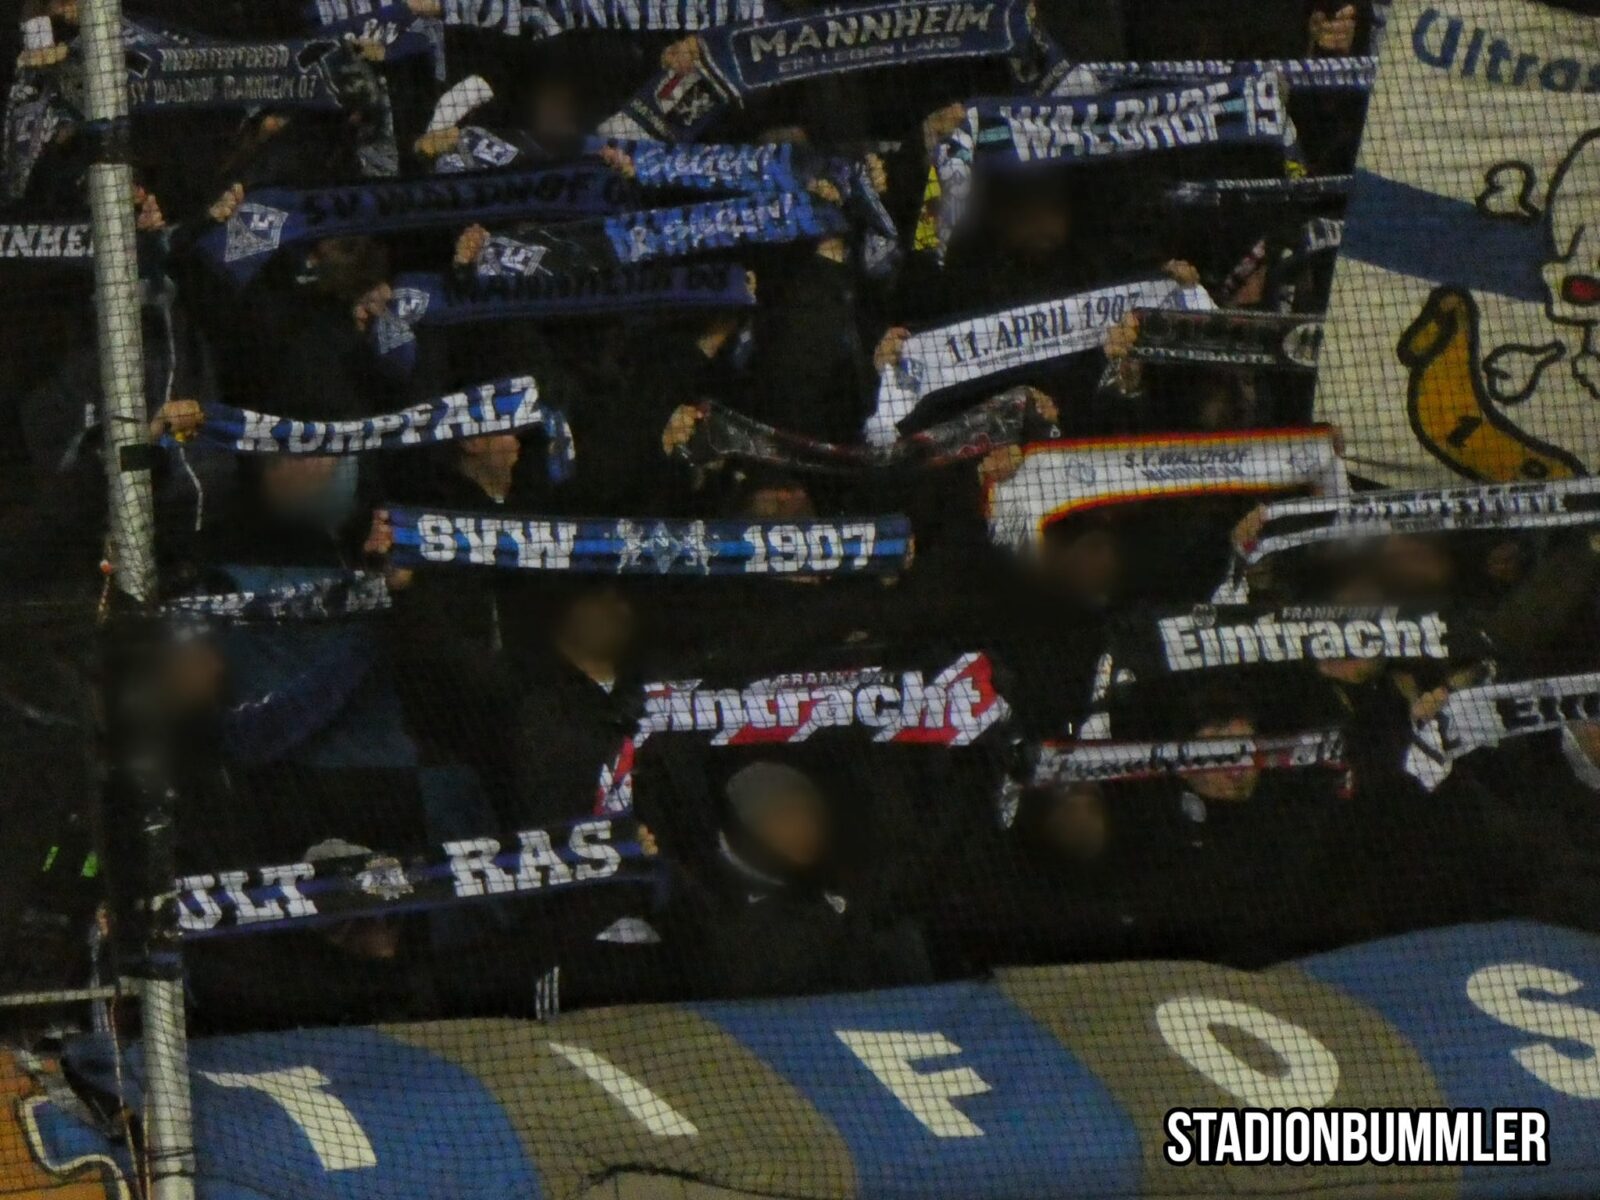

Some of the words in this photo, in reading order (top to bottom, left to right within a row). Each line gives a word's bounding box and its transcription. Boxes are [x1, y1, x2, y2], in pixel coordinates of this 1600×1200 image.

[749, 3, 995, 63] MANNHEIM
[1004, 81, 1230, 163] WALDHOF
[0, 224, 94, 258] NHE
[995, 309, 1074, 351] APRIL
[236, 376, 542, 453] KURPFALZ
[417, 514, 577, 570] SVW
[743, 523, 877, 573] 1907
[1158, 609, 1449, 673] Eintracht
[442, 819, 622, 898] RAS
